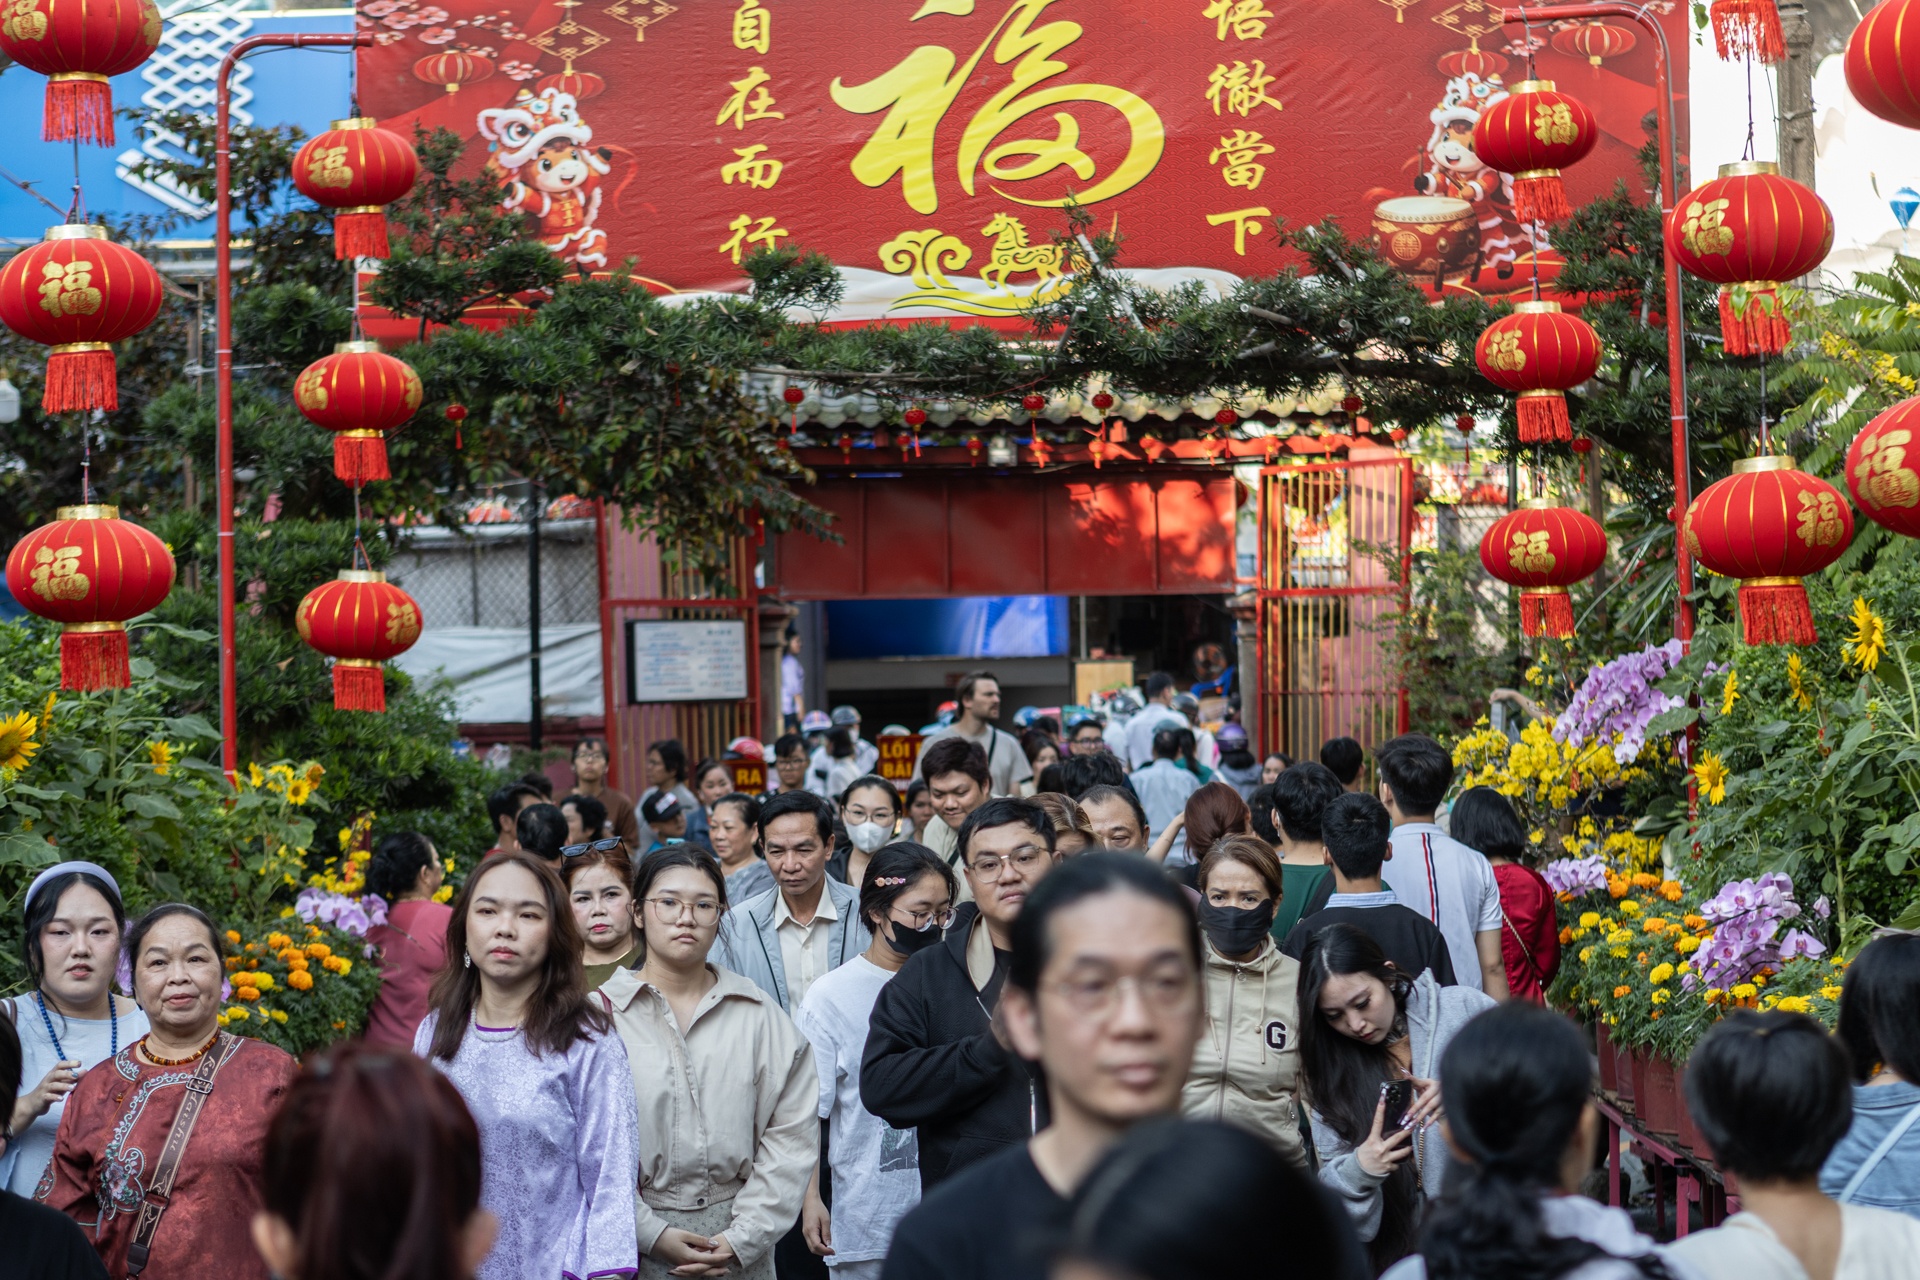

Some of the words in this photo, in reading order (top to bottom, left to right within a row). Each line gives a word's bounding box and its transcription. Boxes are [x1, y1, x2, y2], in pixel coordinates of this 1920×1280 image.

[829, 0, 1165, 215] 福
[1533, 102, 1579, 146] 福
[308, 145, 354, 189] 福
[1680, 198, 1735, 259] 福
[38, 260, 102, 318] 福
[1485, 329, 1526, 373] 福
[1854, 429, 1919, 511] 福
[1796, 489, 1844, 548] 福
[29, 545, 90, 602] 福
[1508, 530, 1556, 574] 福
[385, 602, 419, 645] 福
[736, 768, 762, 785] RA
[1265, 1020, 1287, 1050] G
